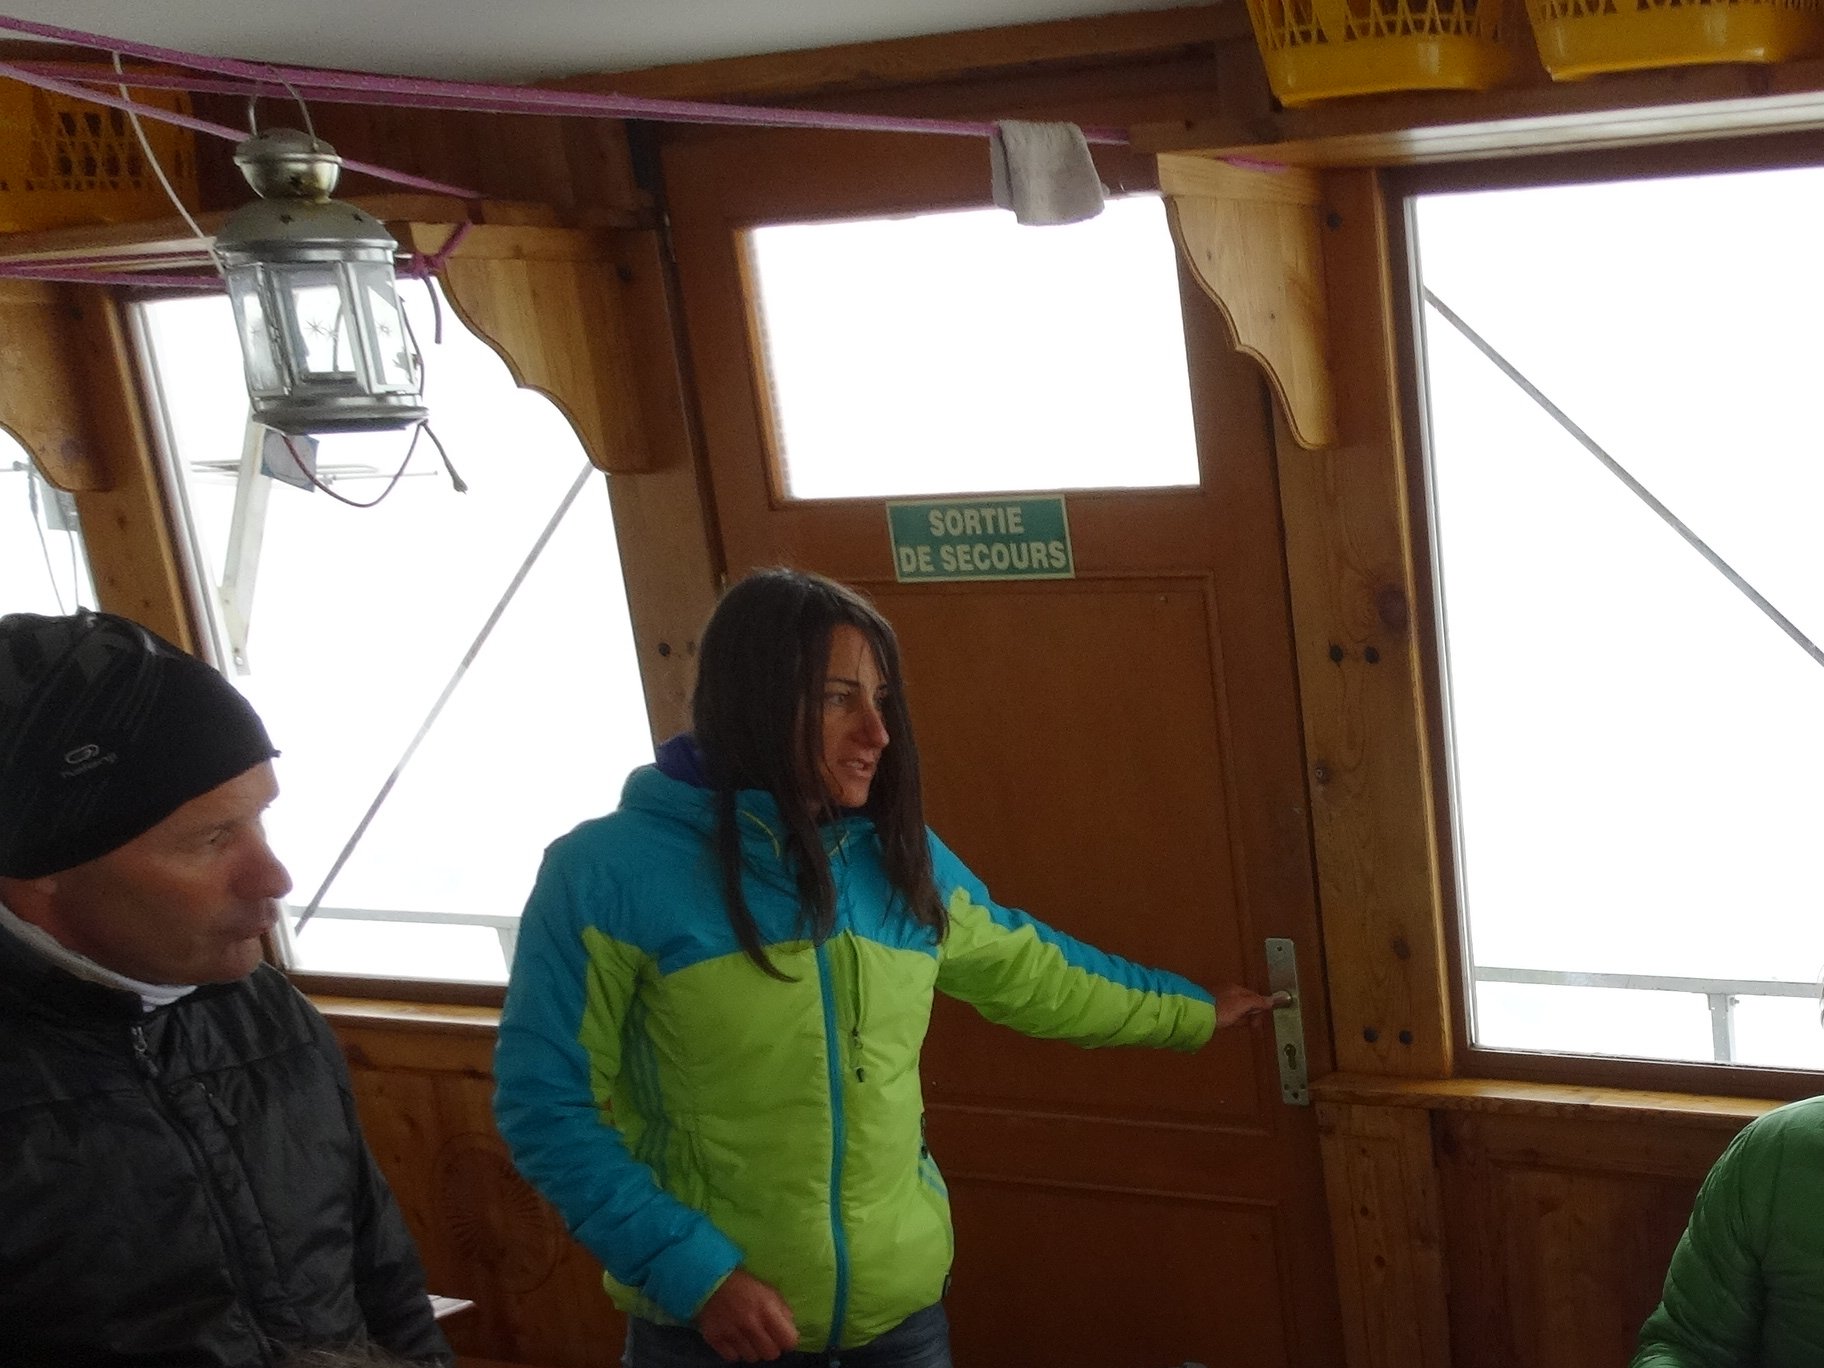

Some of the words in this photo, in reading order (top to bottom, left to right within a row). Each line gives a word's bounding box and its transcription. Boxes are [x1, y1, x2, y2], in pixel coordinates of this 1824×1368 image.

[929, 507, 1024, 537] SORTIE
[899, 545, 935, 573] DE
[940, 541, 1067, 572] SECOURS
